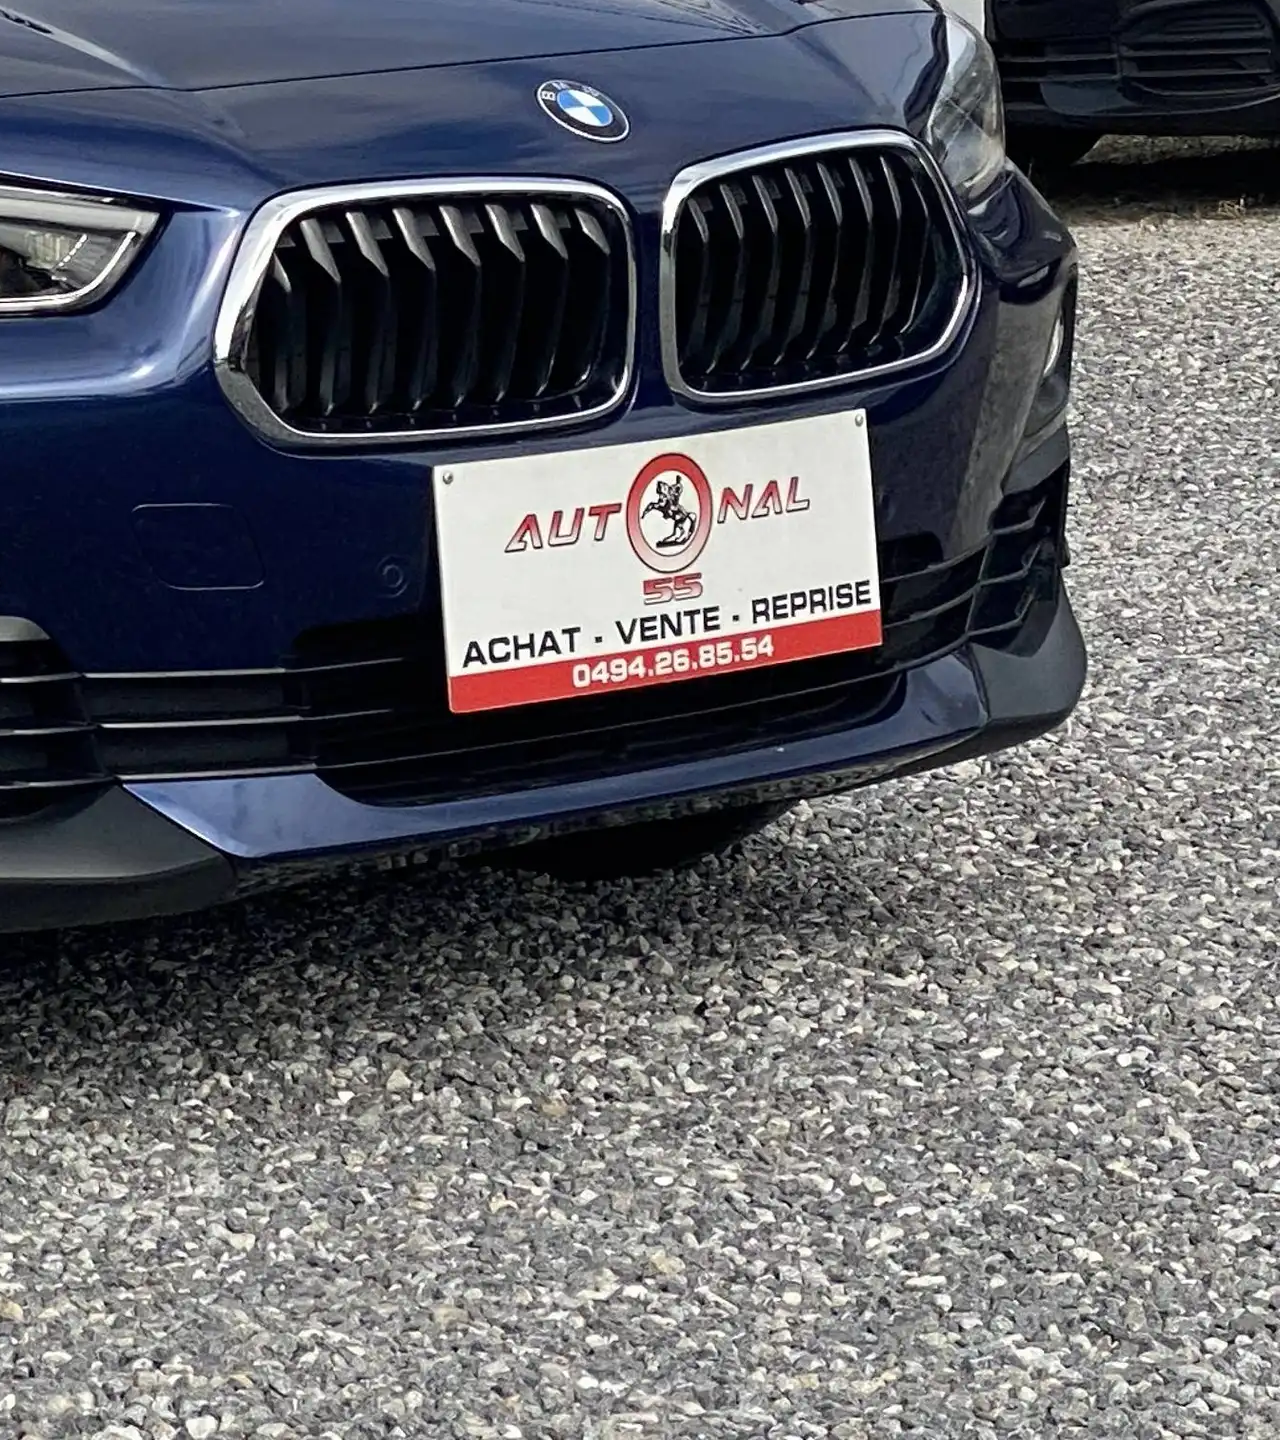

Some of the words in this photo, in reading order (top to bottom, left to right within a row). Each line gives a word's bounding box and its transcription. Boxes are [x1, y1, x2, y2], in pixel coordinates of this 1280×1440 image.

[643, 573, 704, 605] 55
[462, 626, 582, 669] ACHAT
[615, 606, 720, 646] VENTE
[751, 579, 872, 625] REPRISE
[571, 633, 775, 689] 0494.26.85.54
